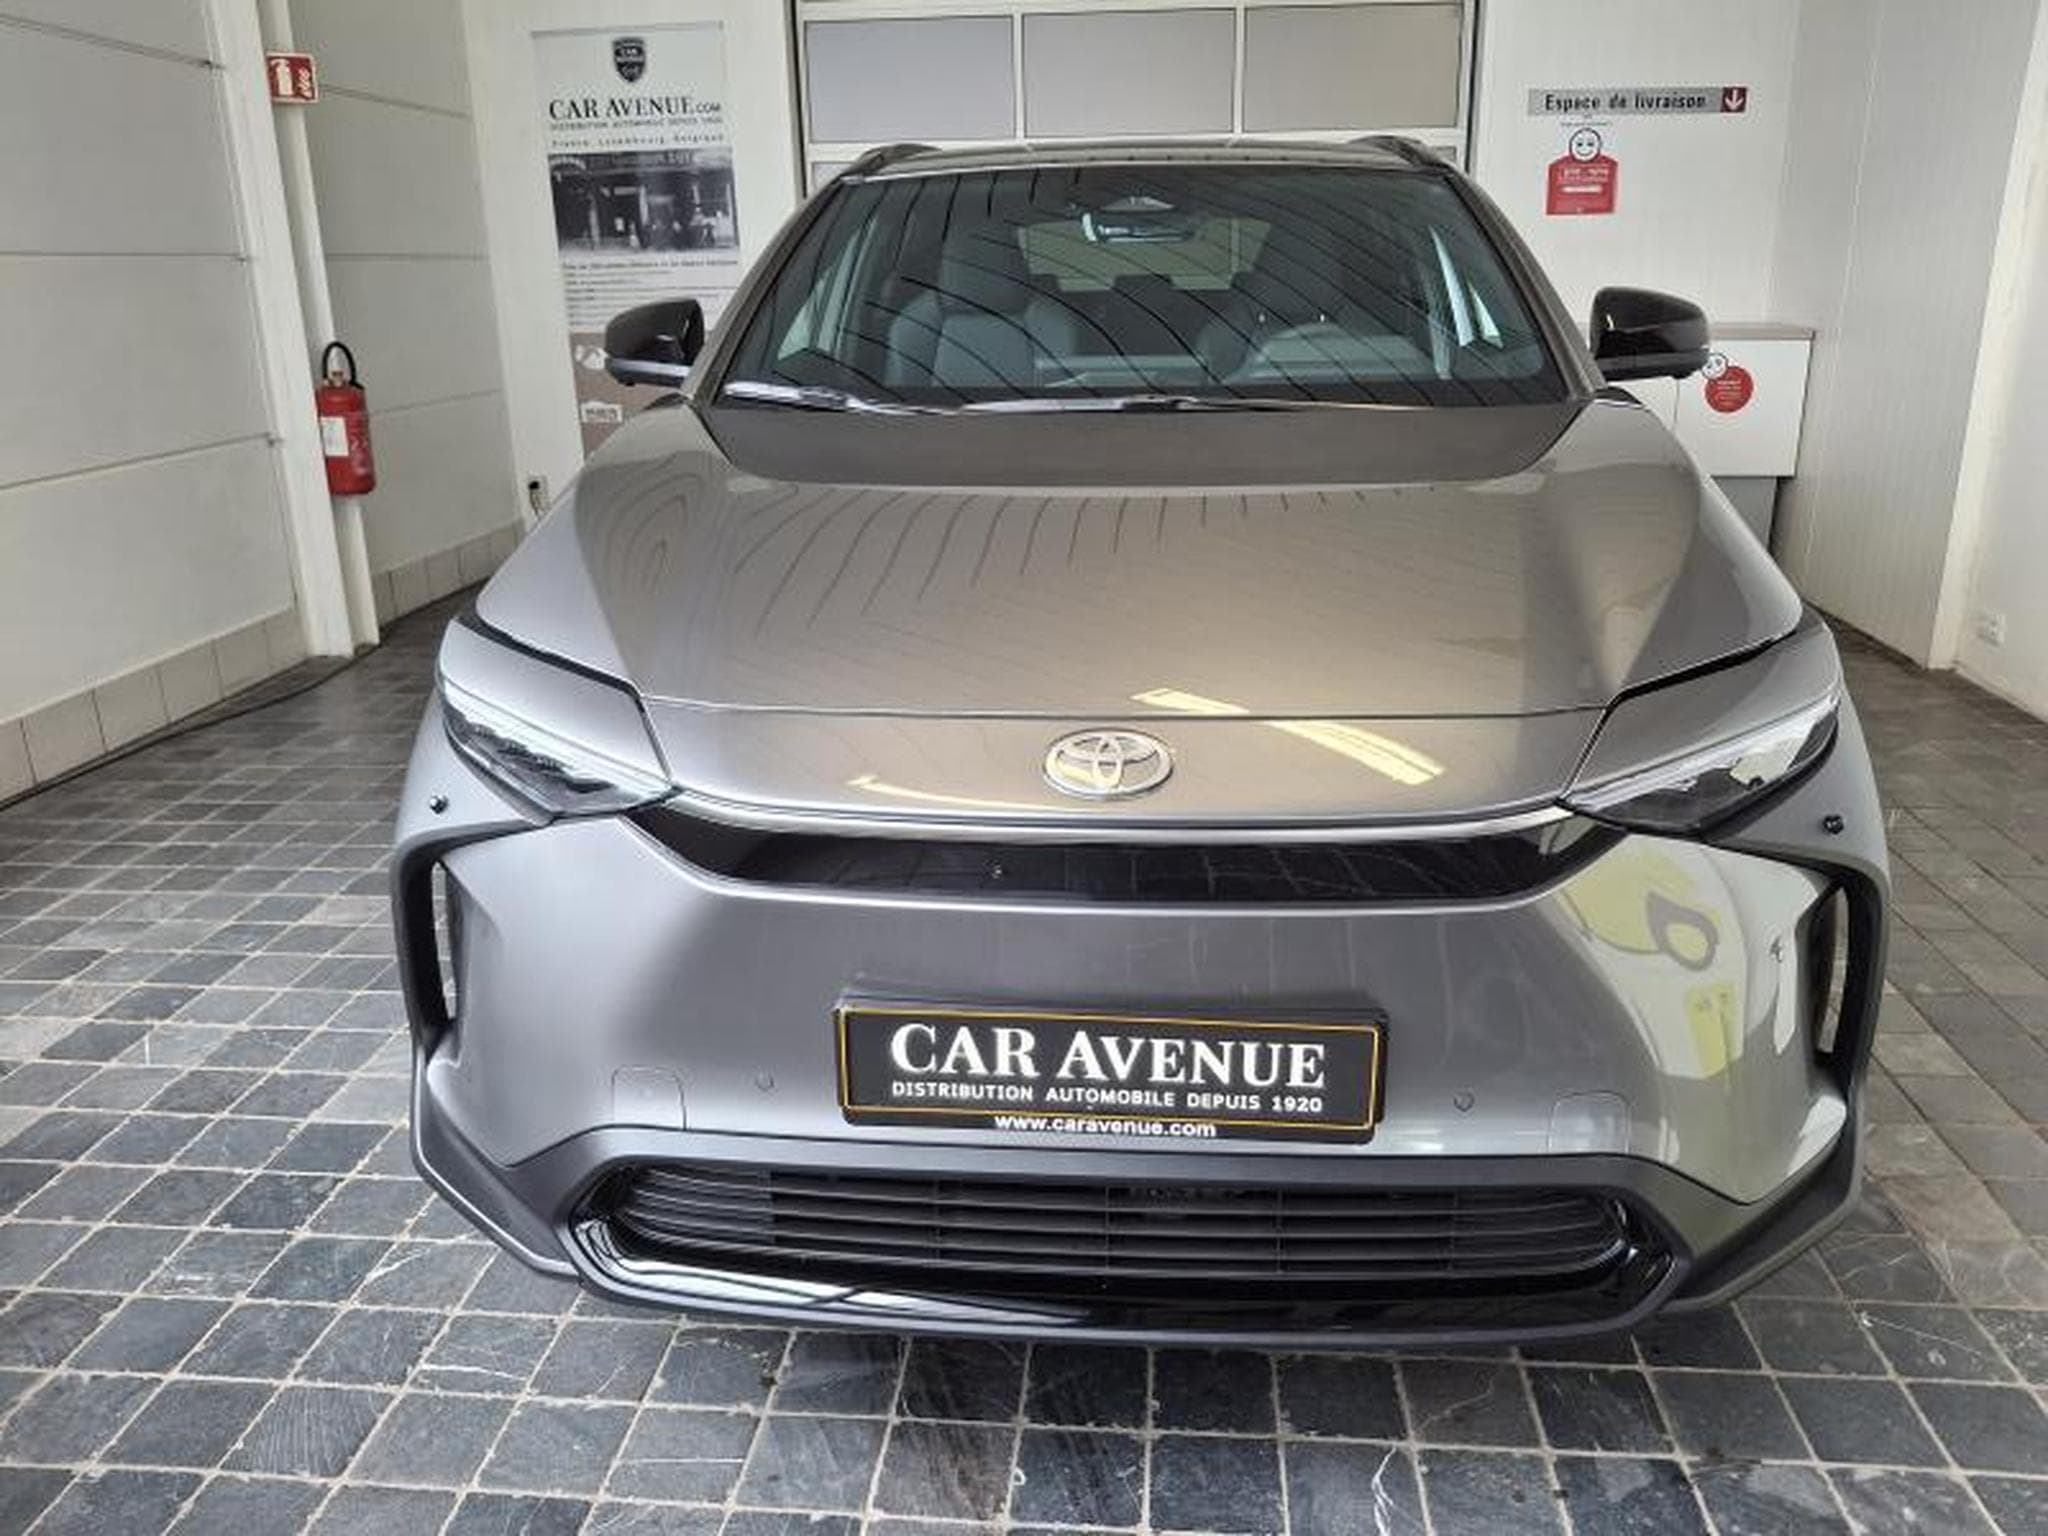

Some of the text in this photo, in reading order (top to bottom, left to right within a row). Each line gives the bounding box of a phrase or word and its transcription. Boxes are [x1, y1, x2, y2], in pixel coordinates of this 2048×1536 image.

[549, 99, 599, 120] CAR
[1545, 91, 1707, 113] Espace de livraison
[890, 1022, 1326, 1089] CAR AVENUE
[892, 1080, 1323, 1113] DISTRIBUTION AUTOMOBILE DEPUIS 1920
[994, 1115, 1218, 1138] www.caravenue.com
